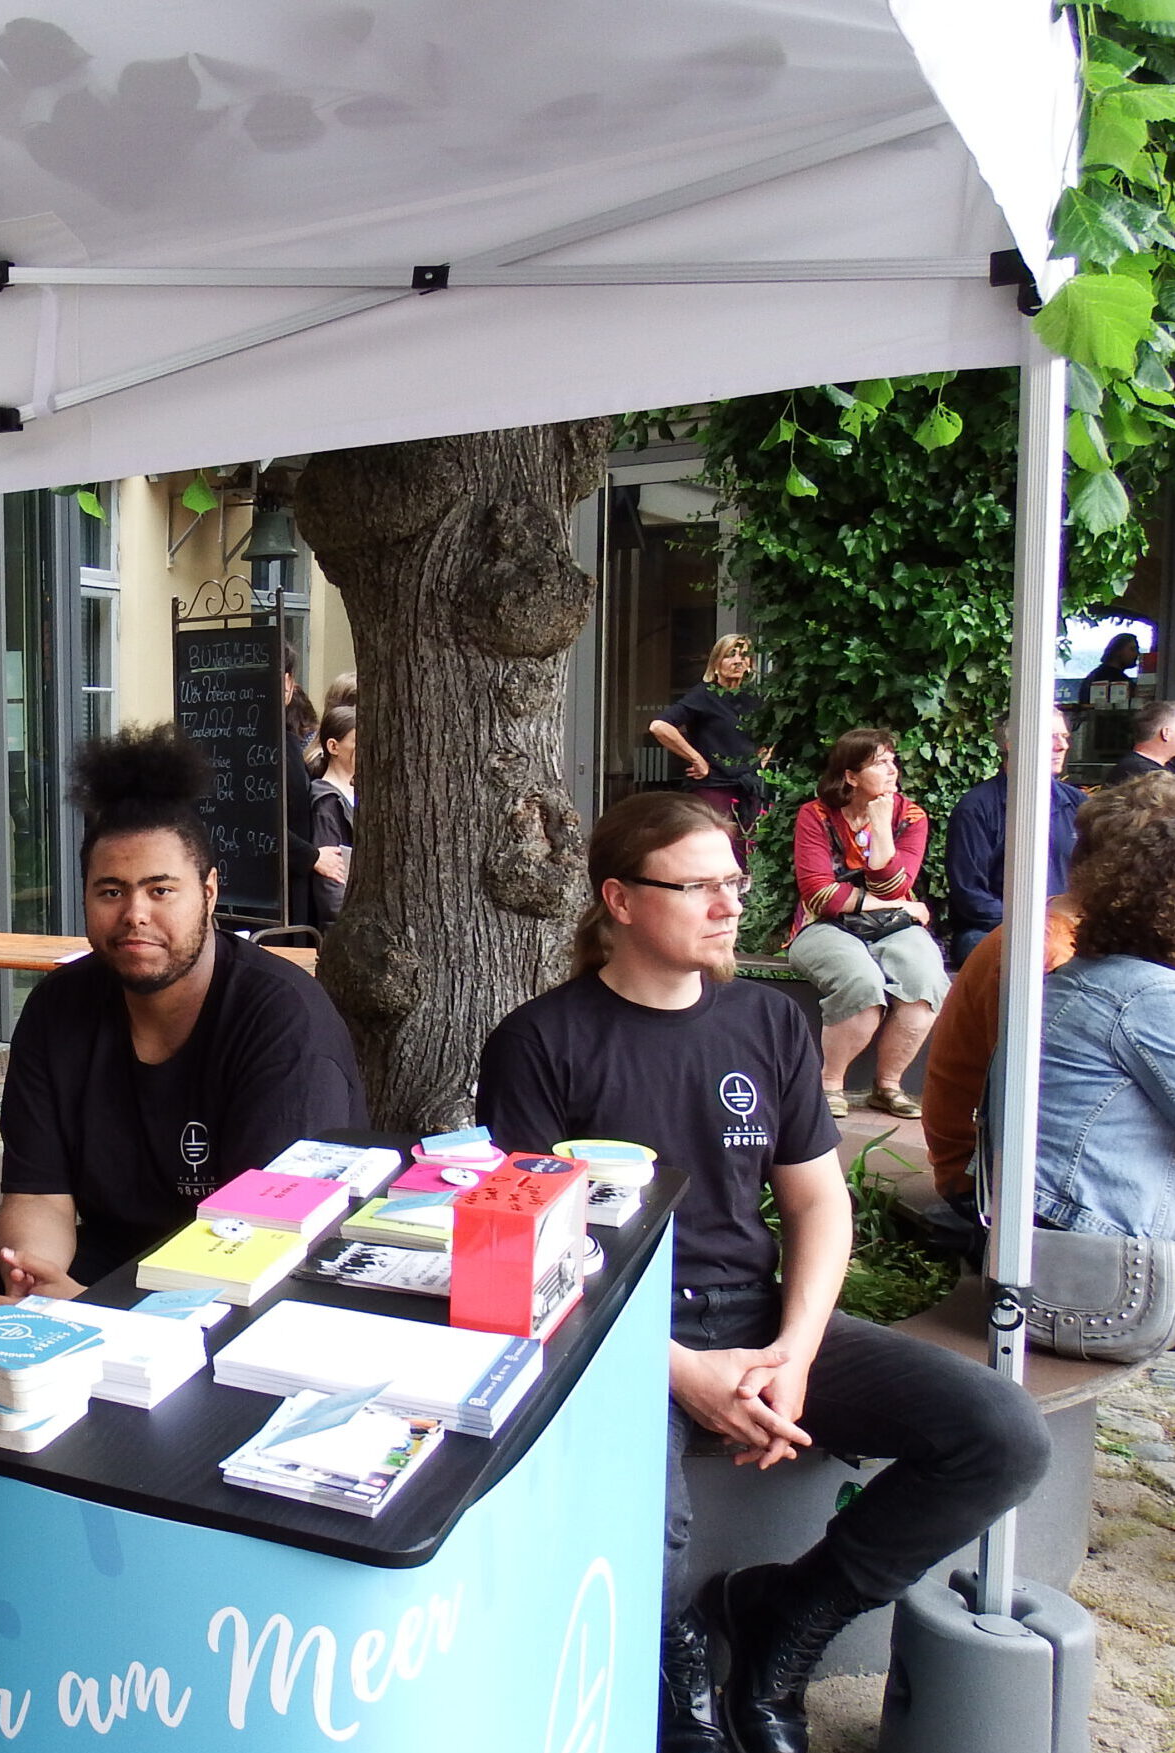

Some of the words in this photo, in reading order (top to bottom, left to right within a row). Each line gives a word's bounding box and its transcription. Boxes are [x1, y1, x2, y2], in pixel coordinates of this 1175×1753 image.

[239, 687, 254, 701] an
[723, 1134, 768, 1148] 98eins
[57, 1660, 192, 1735] am
[207, 1578, 465, 1743] Meer
